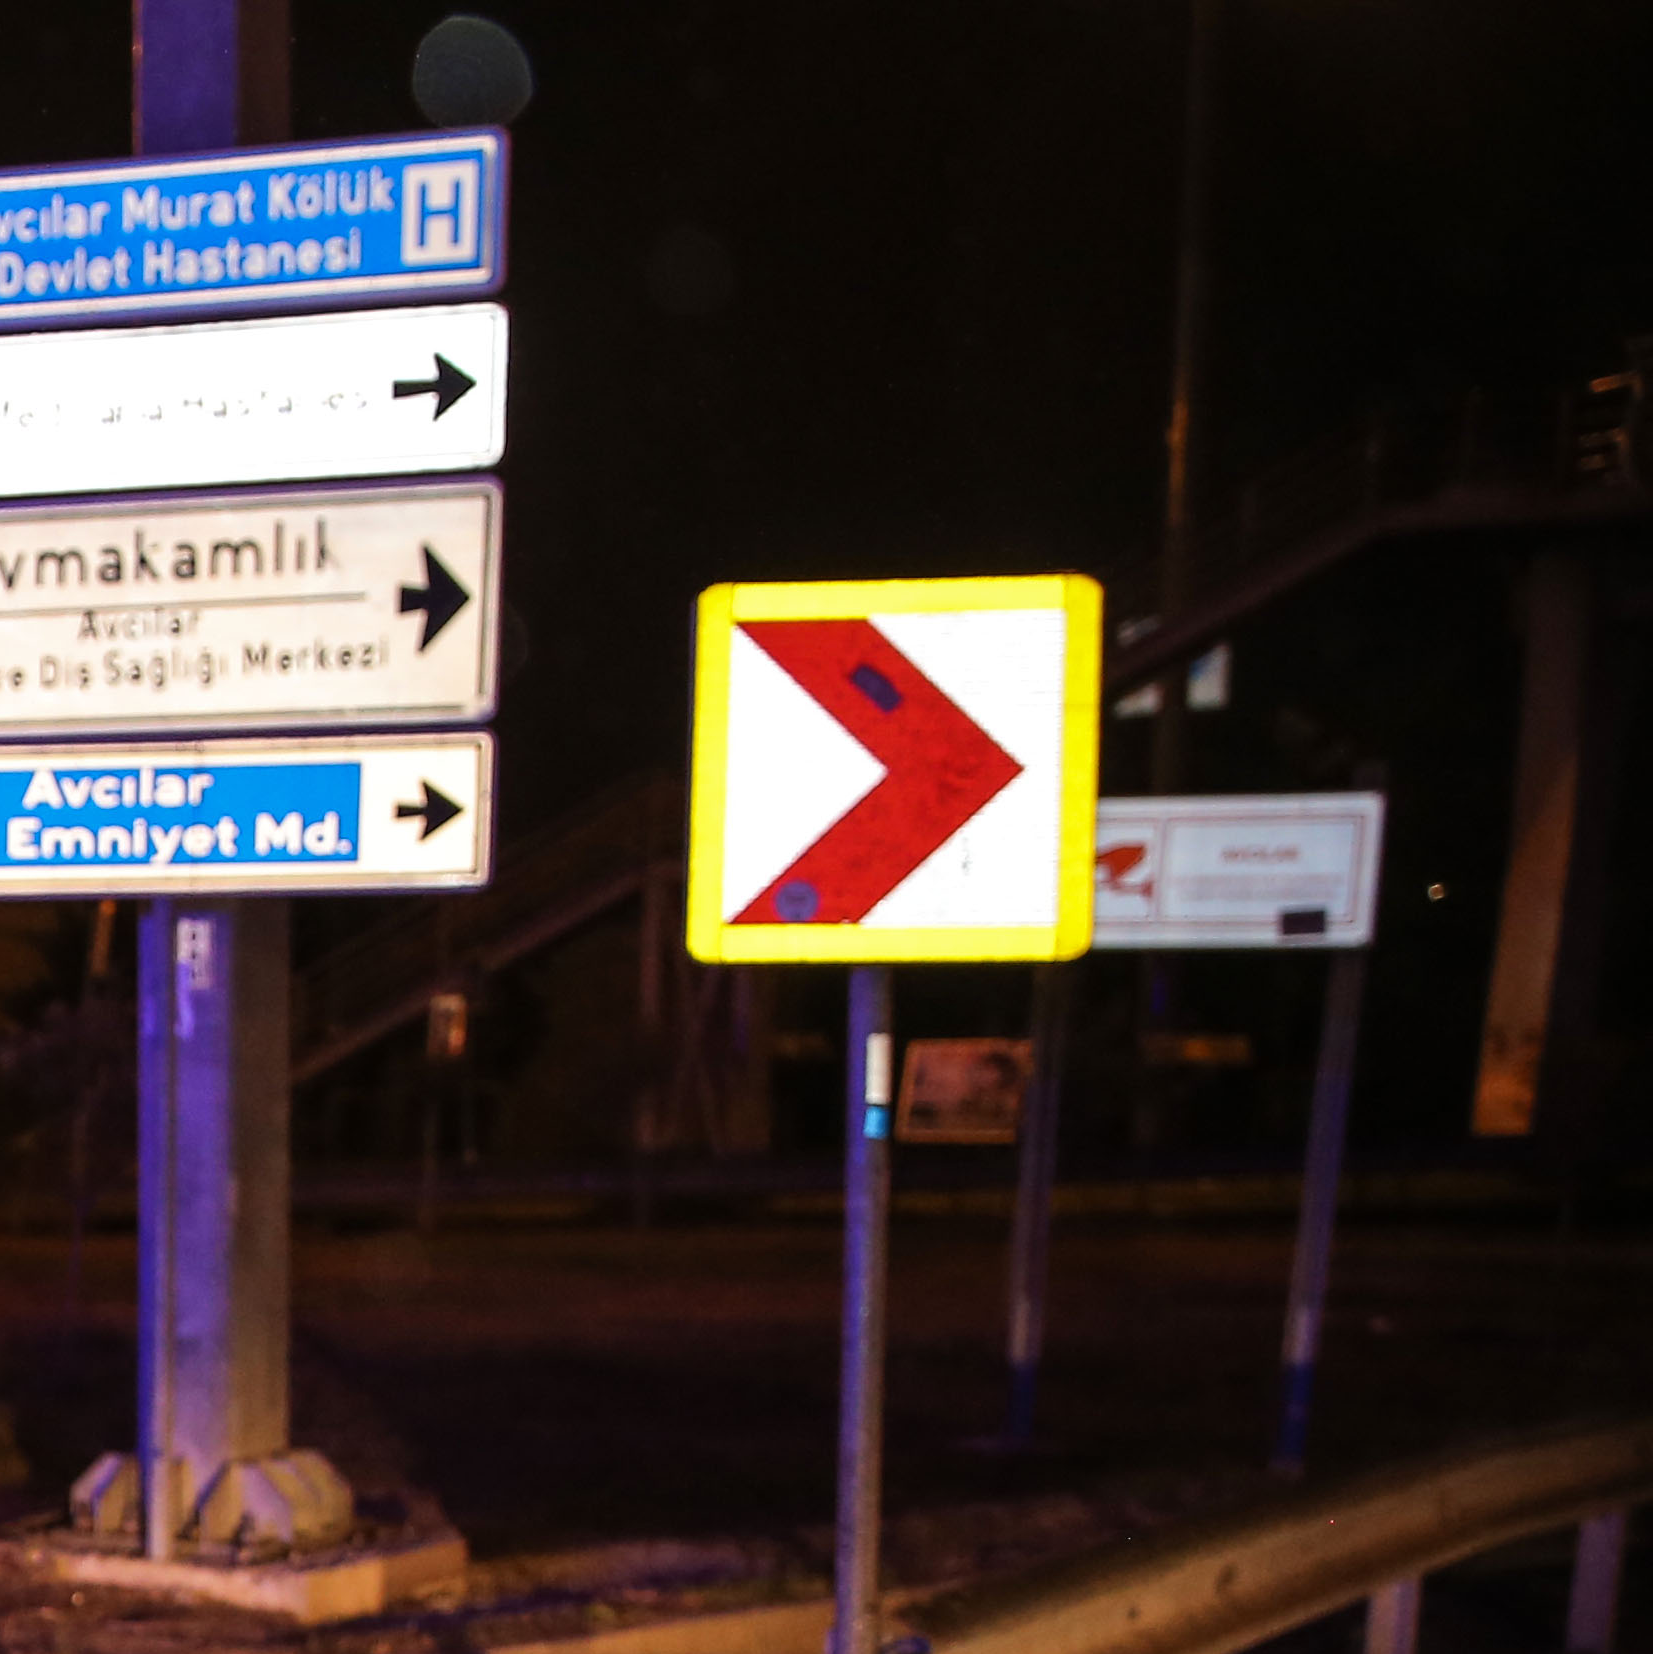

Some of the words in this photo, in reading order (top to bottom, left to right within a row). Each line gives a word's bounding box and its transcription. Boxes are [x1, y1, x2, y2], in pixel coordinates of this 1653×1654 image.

[122, 180, 255, 233] Murat
[144, 226, 362, 286] Hastanesi
[243, 634, 391, 675] Merkezi
[22, 767, 213, 810] Avcılar
[6, 816, 239, 865] Emniyet
[255, 810, 352, 857] Md.
